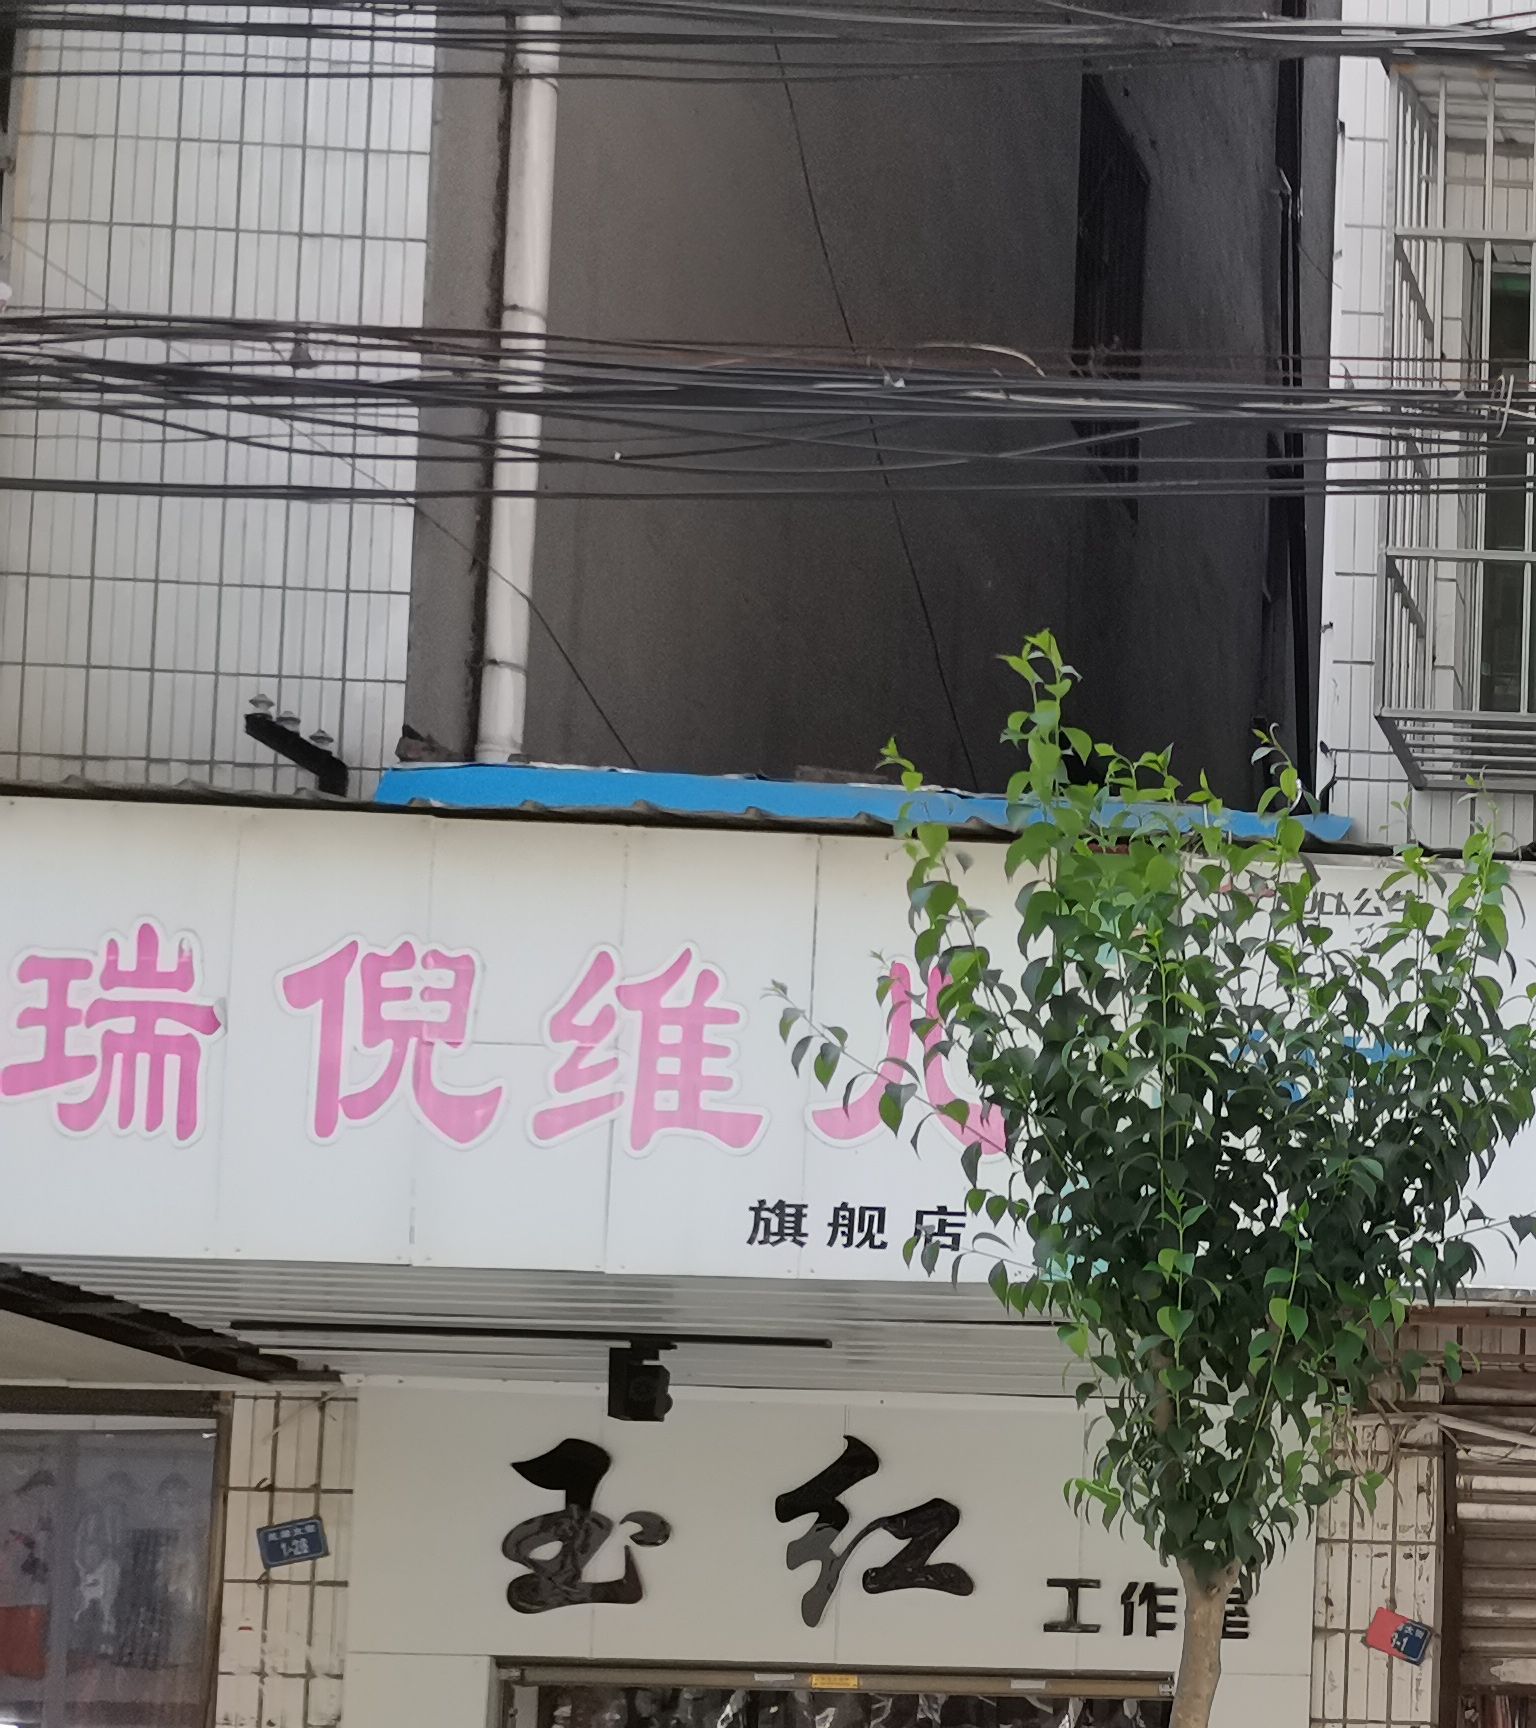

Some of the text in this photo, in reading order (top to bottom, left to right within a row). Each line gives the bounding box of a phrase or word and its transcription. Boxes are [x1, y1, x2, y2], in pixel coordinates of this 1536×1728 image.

[747, 1199, 967, 1252] 旗舰店
[502, 1436, 975, 1627] 玉红
